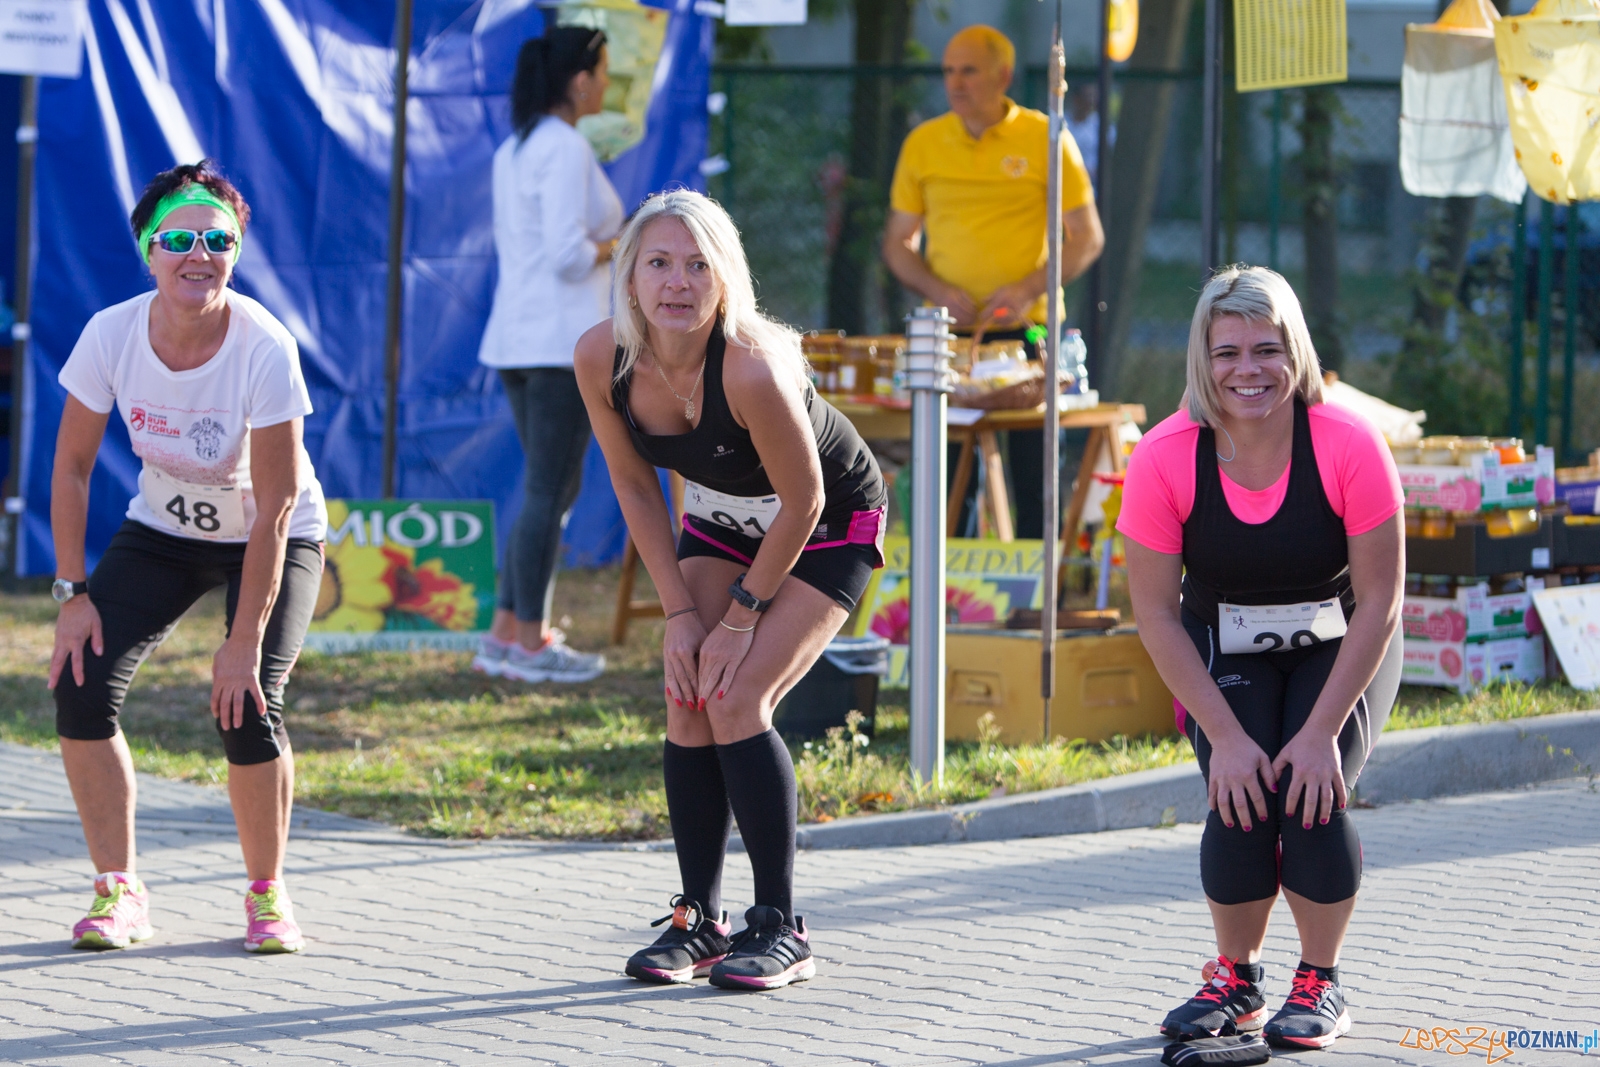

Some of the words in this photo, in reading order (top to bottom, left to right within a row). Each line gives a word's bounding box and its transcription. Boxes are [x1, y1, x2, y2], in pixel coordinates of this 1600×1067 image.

[147, 416, 167, 426] RUN
[166, 494, 221, 532] 48
[327, 503, 483, 548] MIÓD
[711, 510, 767, 536] 91
